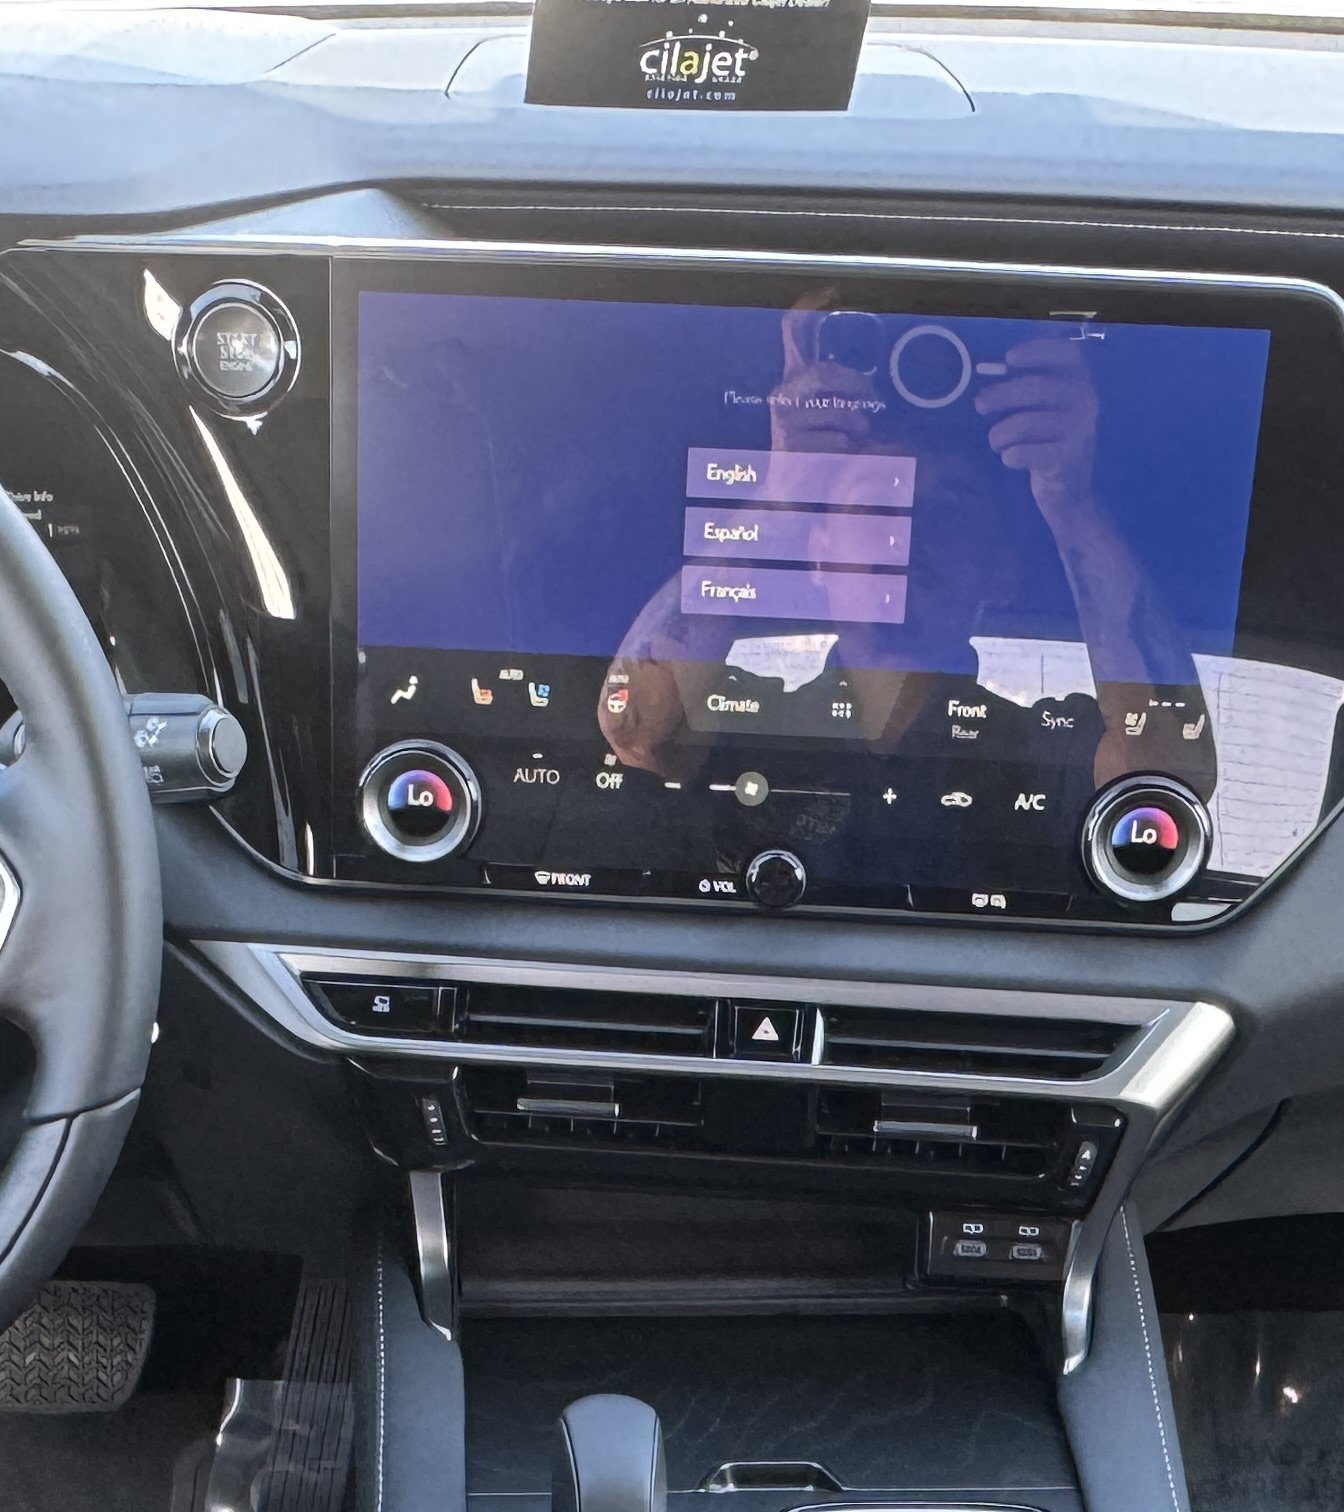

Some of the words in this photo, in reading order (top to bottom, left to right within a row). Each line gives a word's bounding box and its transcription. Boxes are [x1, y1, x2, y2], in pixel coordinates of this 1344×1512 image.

[639, 41, 746, 83] cilajet
[707, 463, 757, 485] English
[703, 522, 759, 543] Español
[701, 580, 757, 603] Français
[707, 693, 760, 714] Climate
[947, 699, 988, 718] Front
[1040, 711, 1074, 730] Sync
[513, 768, 561, 785] AUTO
[595, 773, 624, 789] Off
[408, 784, 434, 807] Lo
[1014, 793, 1047, 811] A/C
[1130, 819, 1158, 845] Lo
